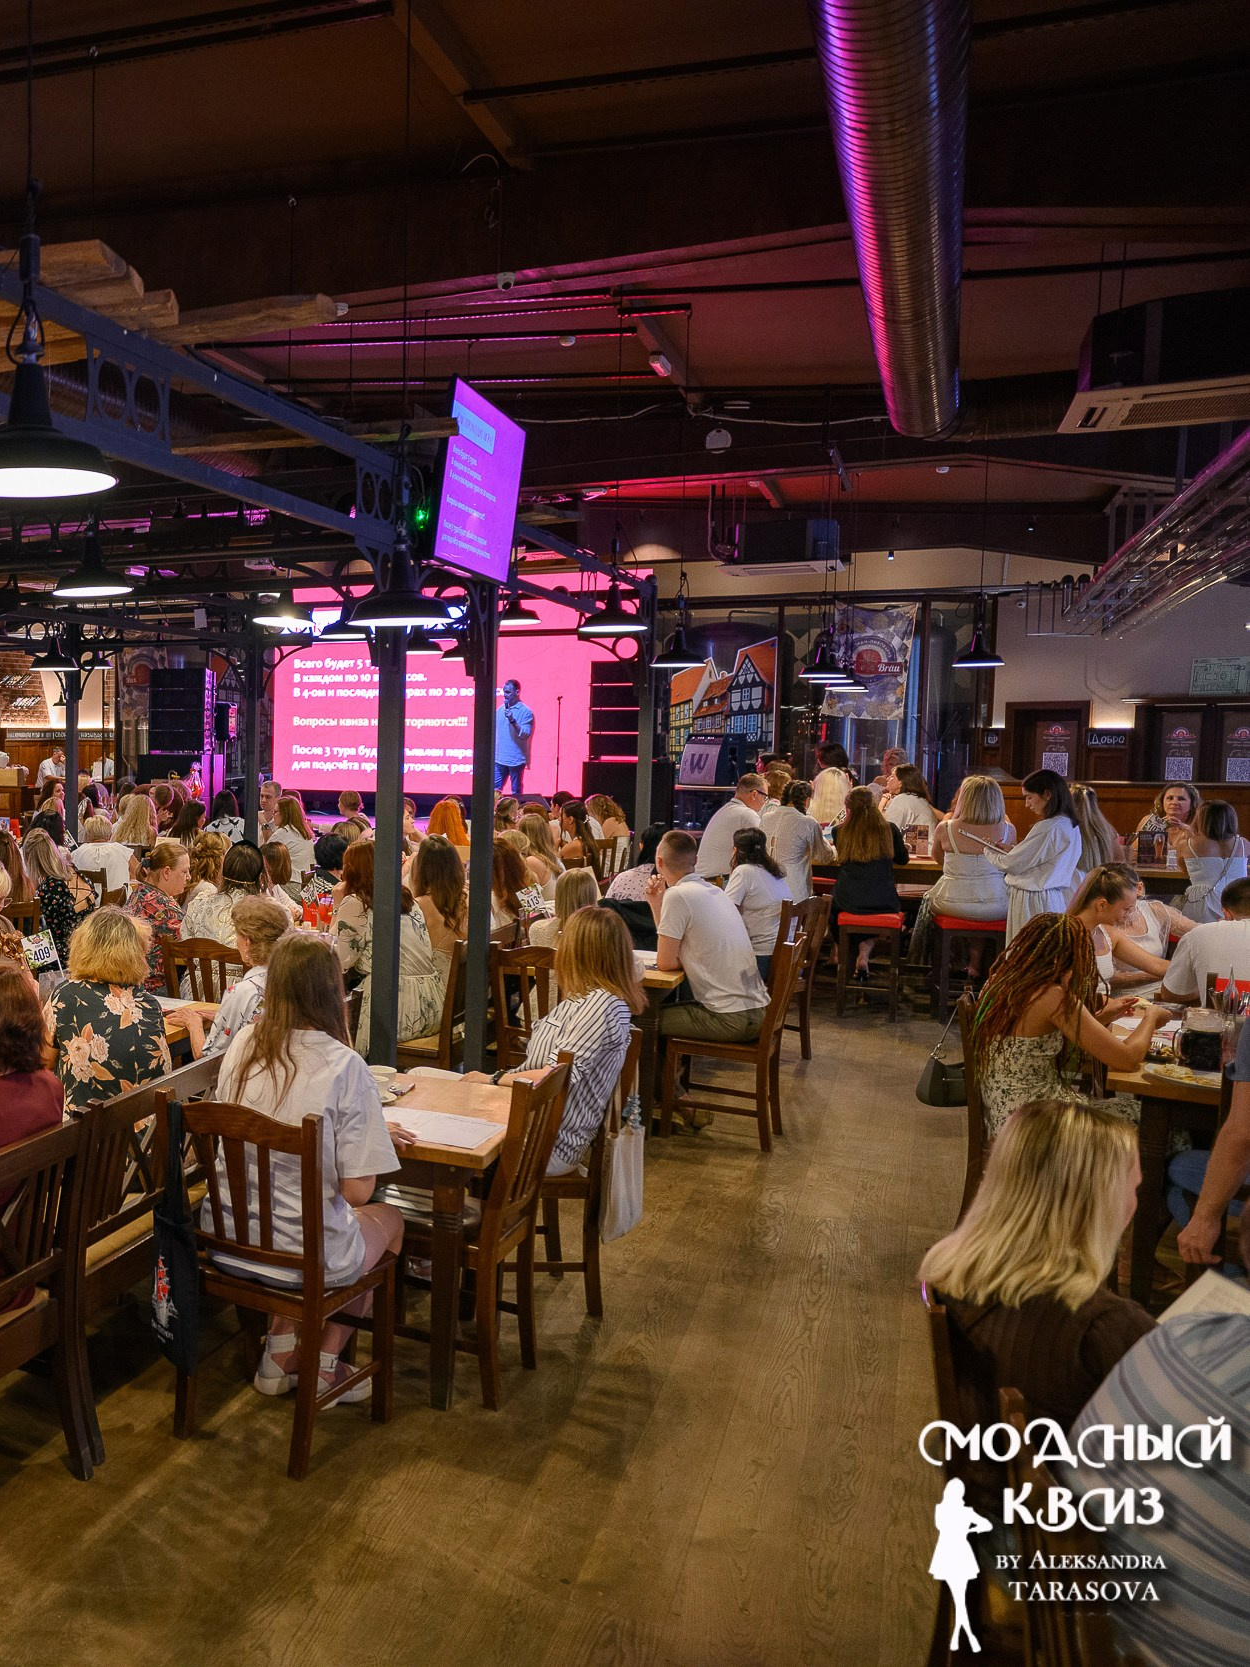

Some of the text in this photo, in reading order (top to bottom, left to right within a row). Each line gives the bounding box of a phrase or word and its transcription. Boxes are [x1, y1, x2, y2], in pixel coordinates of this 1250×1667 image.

[293, 659, 323, 669] Всего
[324, 658, 355, 671] будет
[356, 659, 364, 670] 5
[293, 673, 301, 683] В
[302, 674, 344, 685] каждом
[344, 674, 358, 683] по
[293, 688, 301, 697] В
[302, 689, 326, 699] 4-ом
[327, 689, 334, 697] и
[428, 688, 443, 697] по
[444, 687, 458, 697] 20
[293, 716, 337, 729] Вопросы
[339, 718, 369, 727] квиза
[292, 744, 323, 755] После
[324, 746, 331, 757] 3
[332, 747, 356, 758] тура
[291, 761, 310, 771] для
[312, 760, 359, 771] подсчёта
[526, 895, 540, 908] 413
[33, 946, 51, 963] 409
